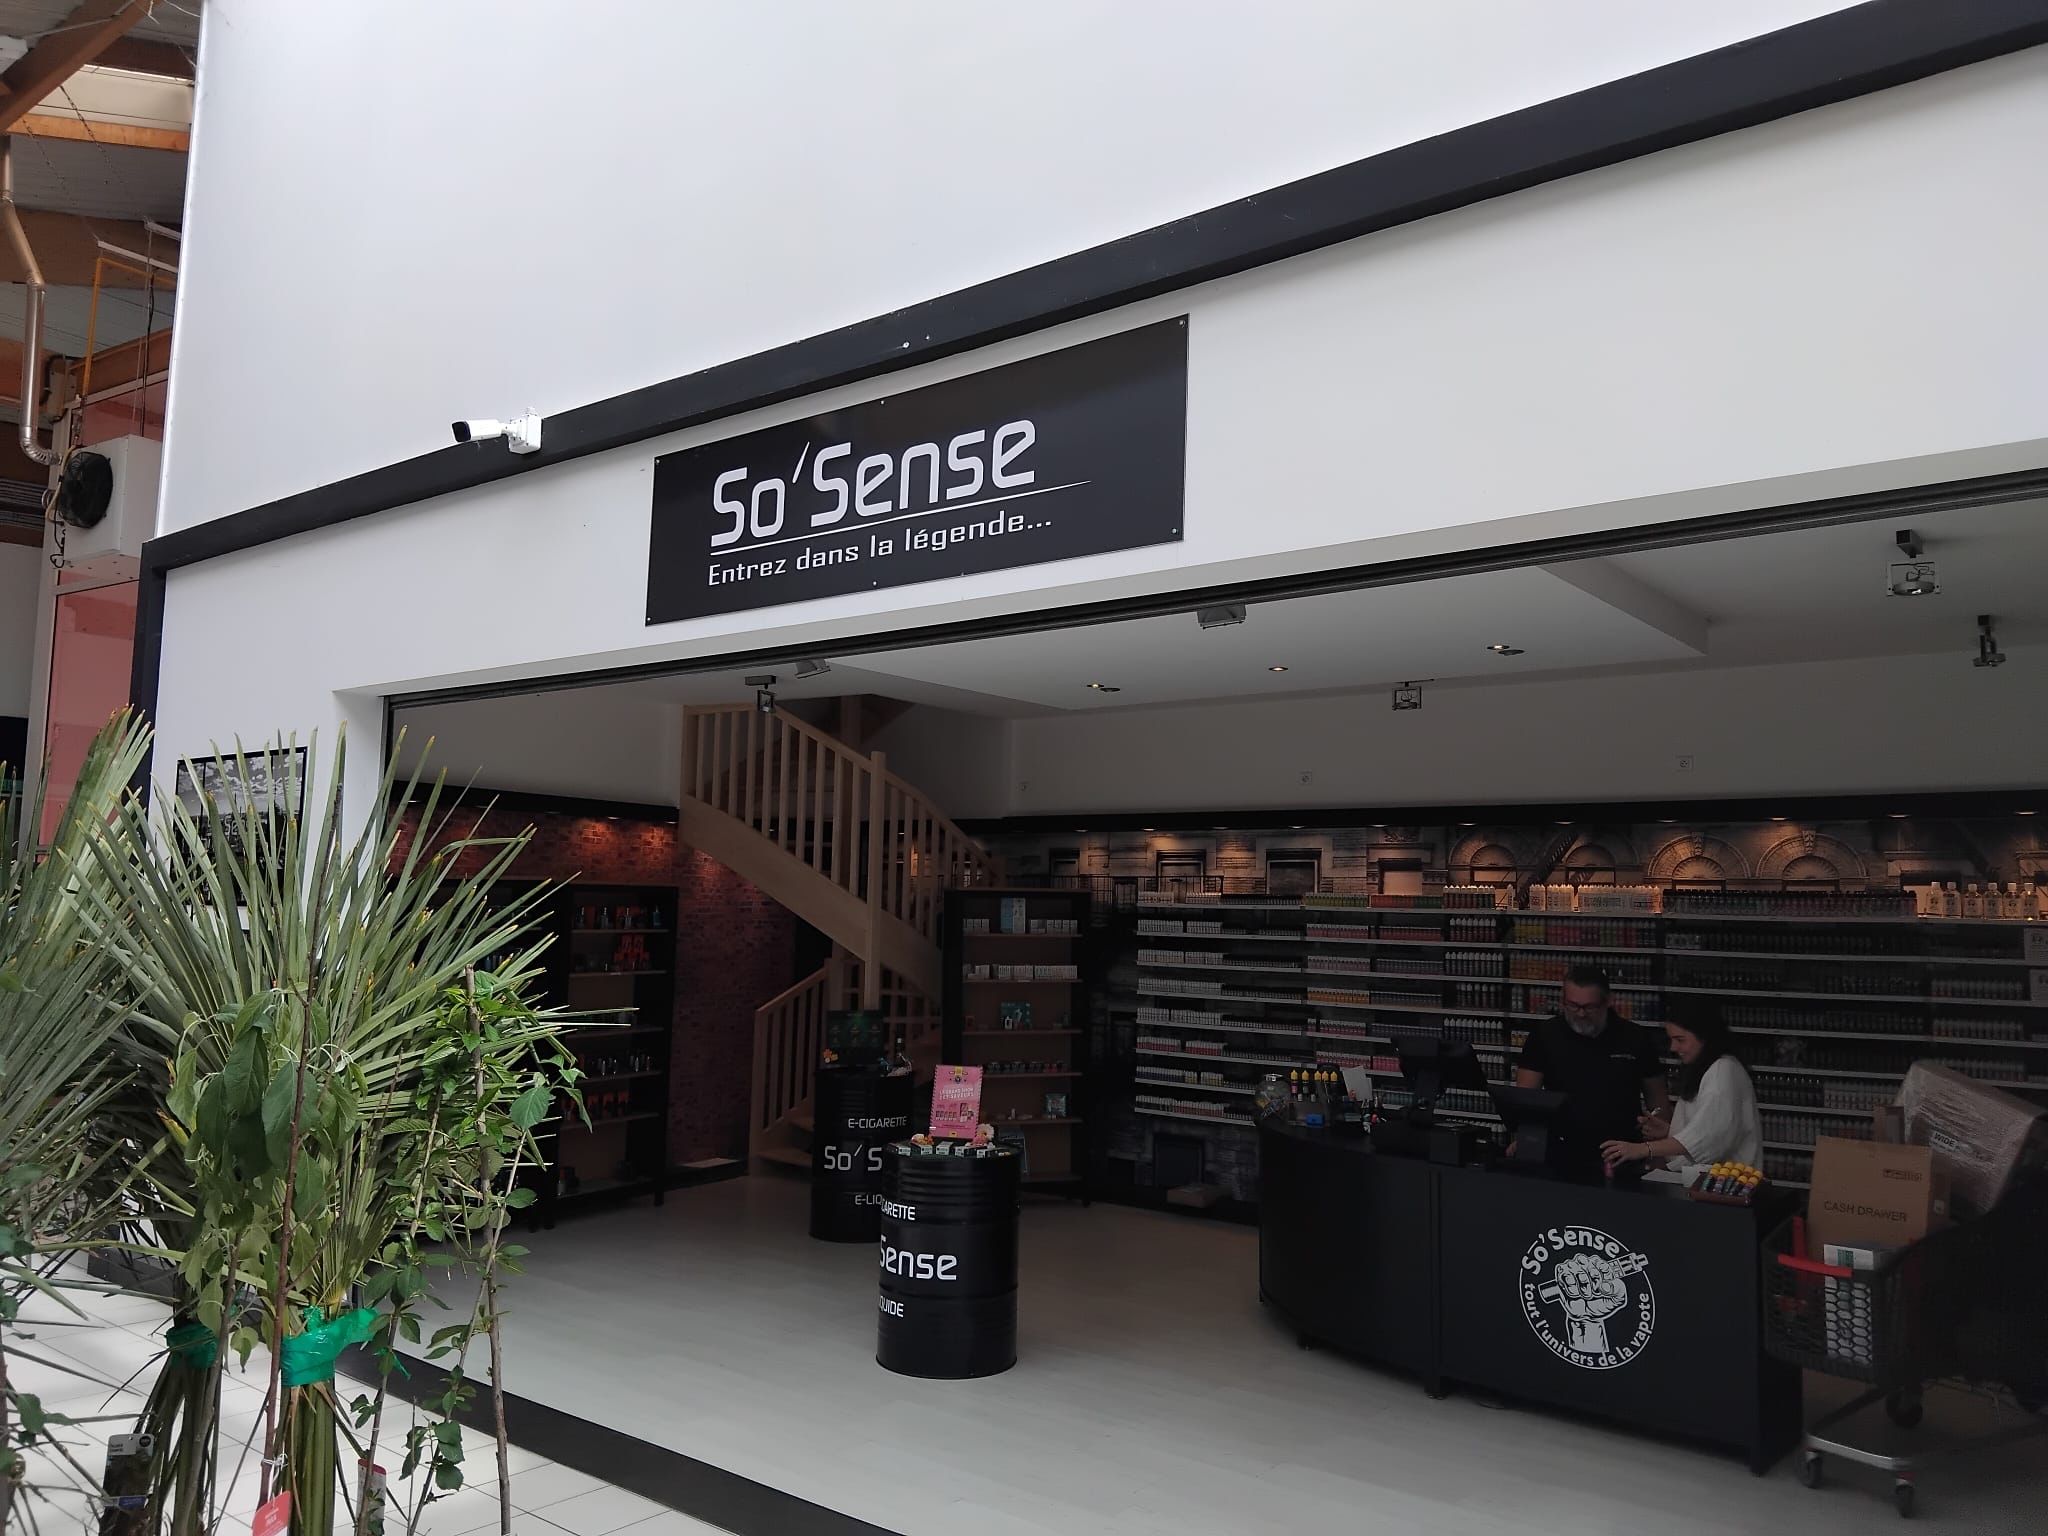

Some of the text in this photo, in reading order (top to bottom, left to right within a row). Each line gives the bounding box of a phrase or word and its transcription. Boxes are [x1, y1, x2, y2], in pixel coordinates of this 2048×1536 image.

[710, 419, 1036, 548] So'Sense
[708, 511, 1053, 586] Entrez dans la légende...
[848, 1116, 907, 1129] E-CIGARETTE
[823, 1144, 883, 1171] So'S
[854, 1194, 883, 1206] E-LIQ
[1823, 1200, 1907, 1222] CASH DRAWER
[880, 1234, 957, 1280] Sense
[1521, 1228, 1620, 1274] So'Sense
[879, 1295, 904, 1317] QUIDE
[1524, 1282, 1653, 1367] tout l'univers de la vapote
